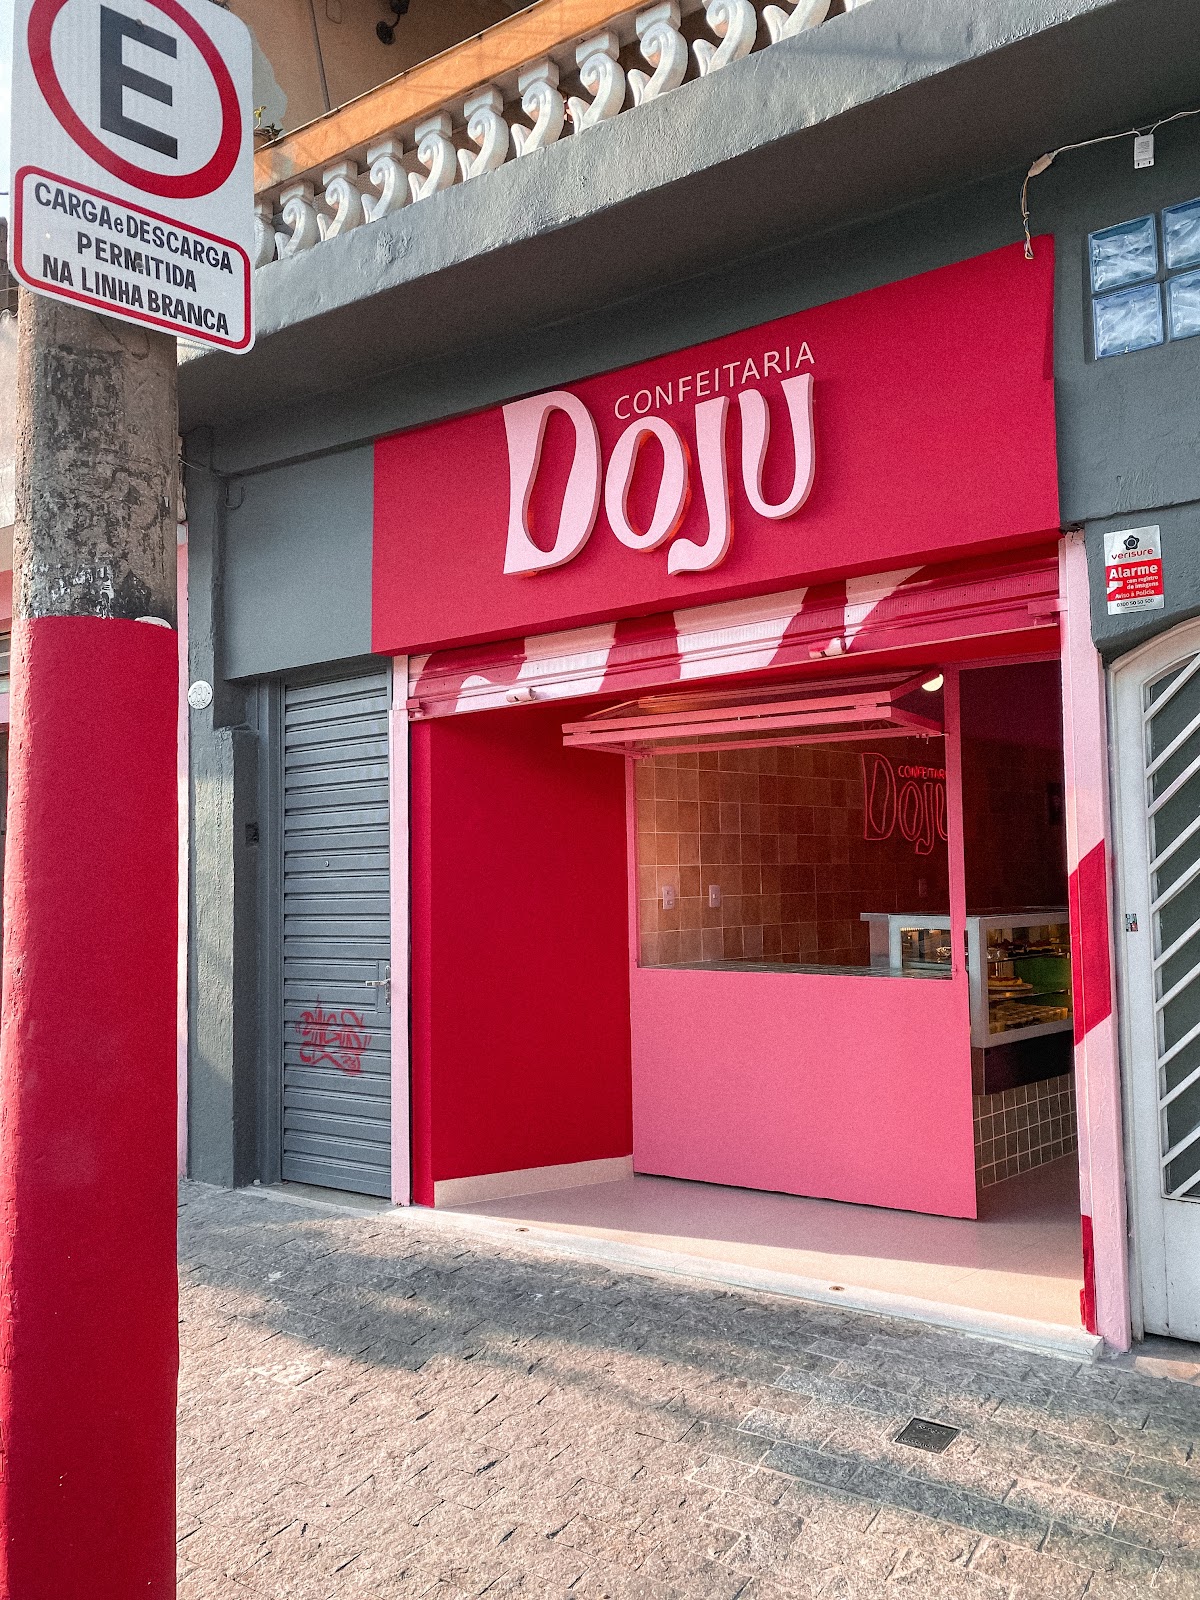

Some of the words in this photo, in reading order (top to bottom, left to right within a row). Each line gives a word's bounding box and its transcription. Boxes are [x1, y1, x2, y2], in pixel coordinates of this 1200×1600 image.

[100, 4, 178, 160] E
[35, 182, 113, 231] CARGA
[126, 214, 233, 275] DESCARGA
[77, 231, 197, 292] PERMITIDA
[43, 253, 74, 287] NA
[82, 266, 144, 309] LINHA
[147, 288, 229, 336] BRANCA
[614, 341, 815, 420] CONFEITARIA
[1109, 564, 1158, 580] Alarme
[1111, 548, 1154, 560] verisure
[1135, 581, 1159, 589] imagens
[898, 765, 946, 780] CONFEITAR
